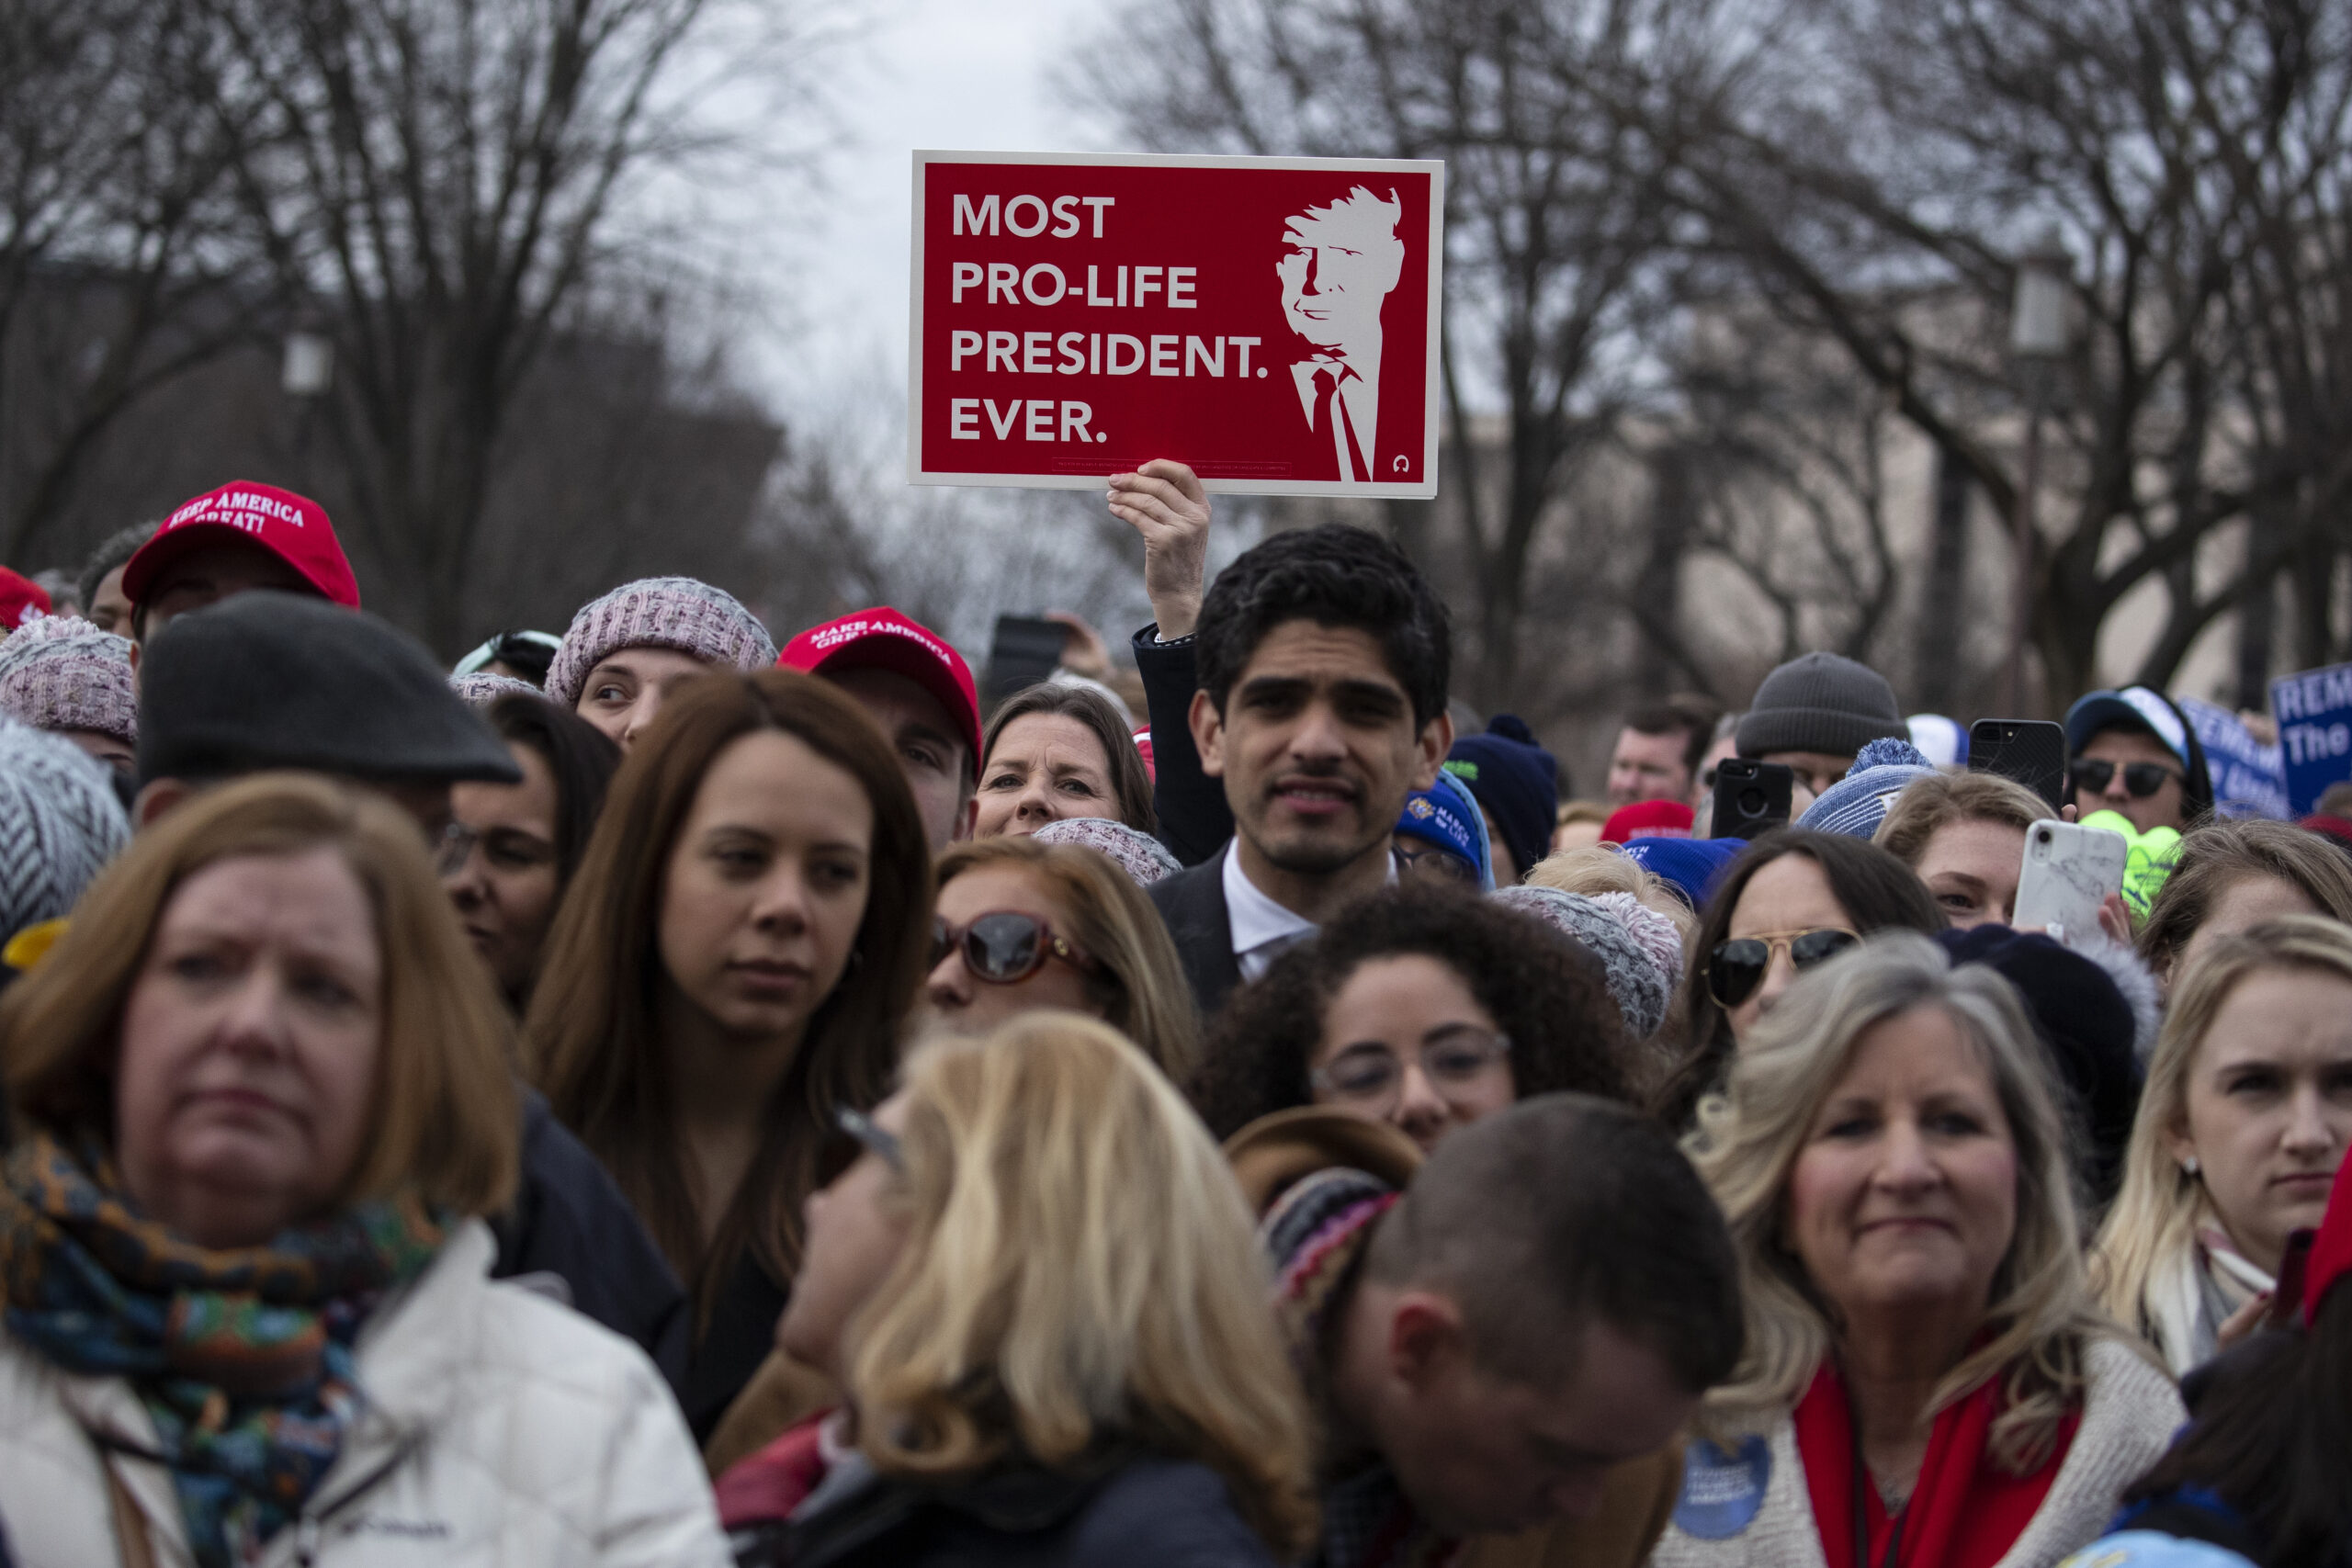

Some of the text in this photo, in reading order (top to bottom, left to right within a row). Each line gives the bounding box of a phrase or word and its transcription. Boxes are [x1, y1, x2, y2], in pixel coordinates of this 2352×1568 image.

[953, 193, 1115, 239] MOST
[952, 262, 1198, 310] PRO-LIFE
[950, 330, 1269, 379] PRESIDENT.
[950, 398, 1108, 444] EVER.
[168, 491, 304, 530] KEEP AMERICA
[810, 620, 868, 645] MAKE
[2285, 722, 2350, 766] The
[1436, 806, 1470, 842] MARCH
